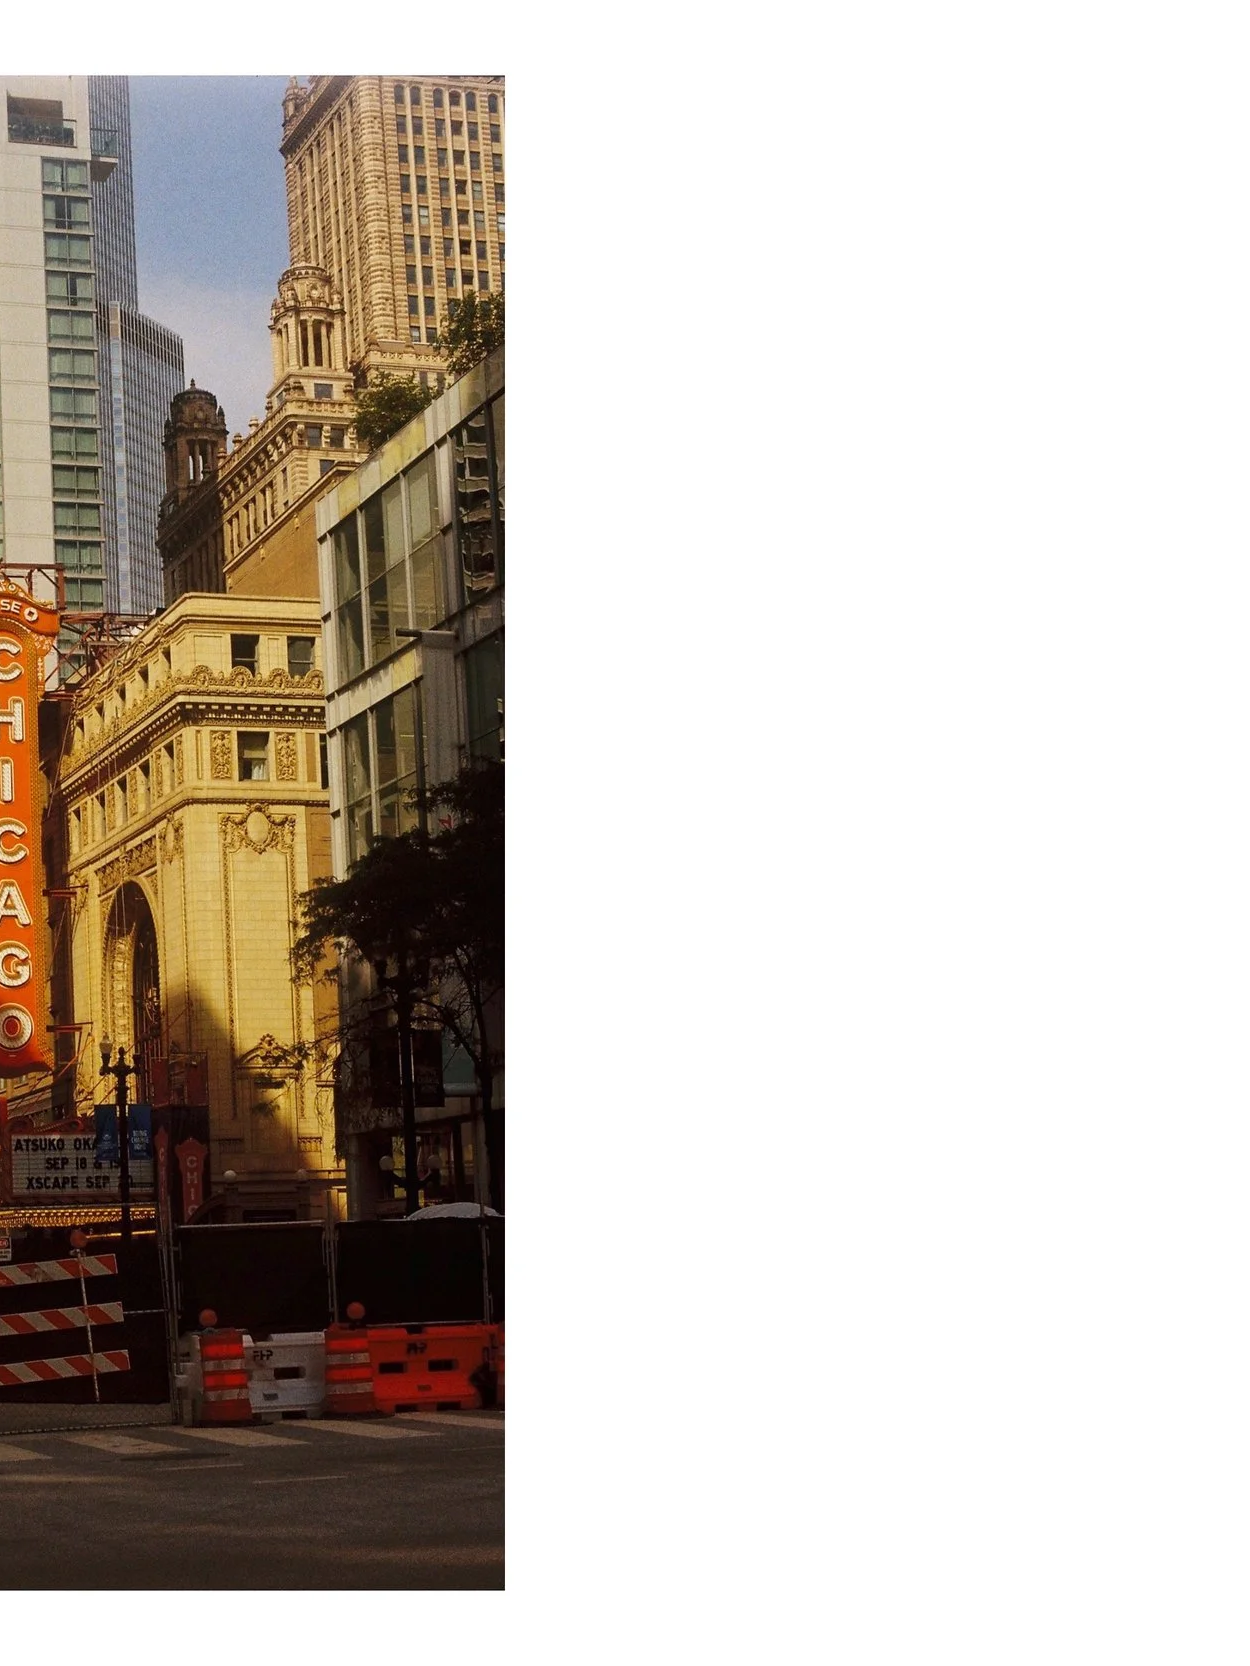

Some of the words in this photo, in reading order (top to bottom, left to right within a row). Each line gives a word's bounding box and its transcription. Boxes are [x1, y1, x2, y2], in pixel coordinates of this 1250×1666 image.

[14, 1138, 65, 1151] ATSUKO
[45, 1157, 69, 1170] SEP
[76, 1157, 87, 1170] 18
[26, 1176, 79, 1190] XSCAPE
[85, 1175, 111, 1189] SEP
